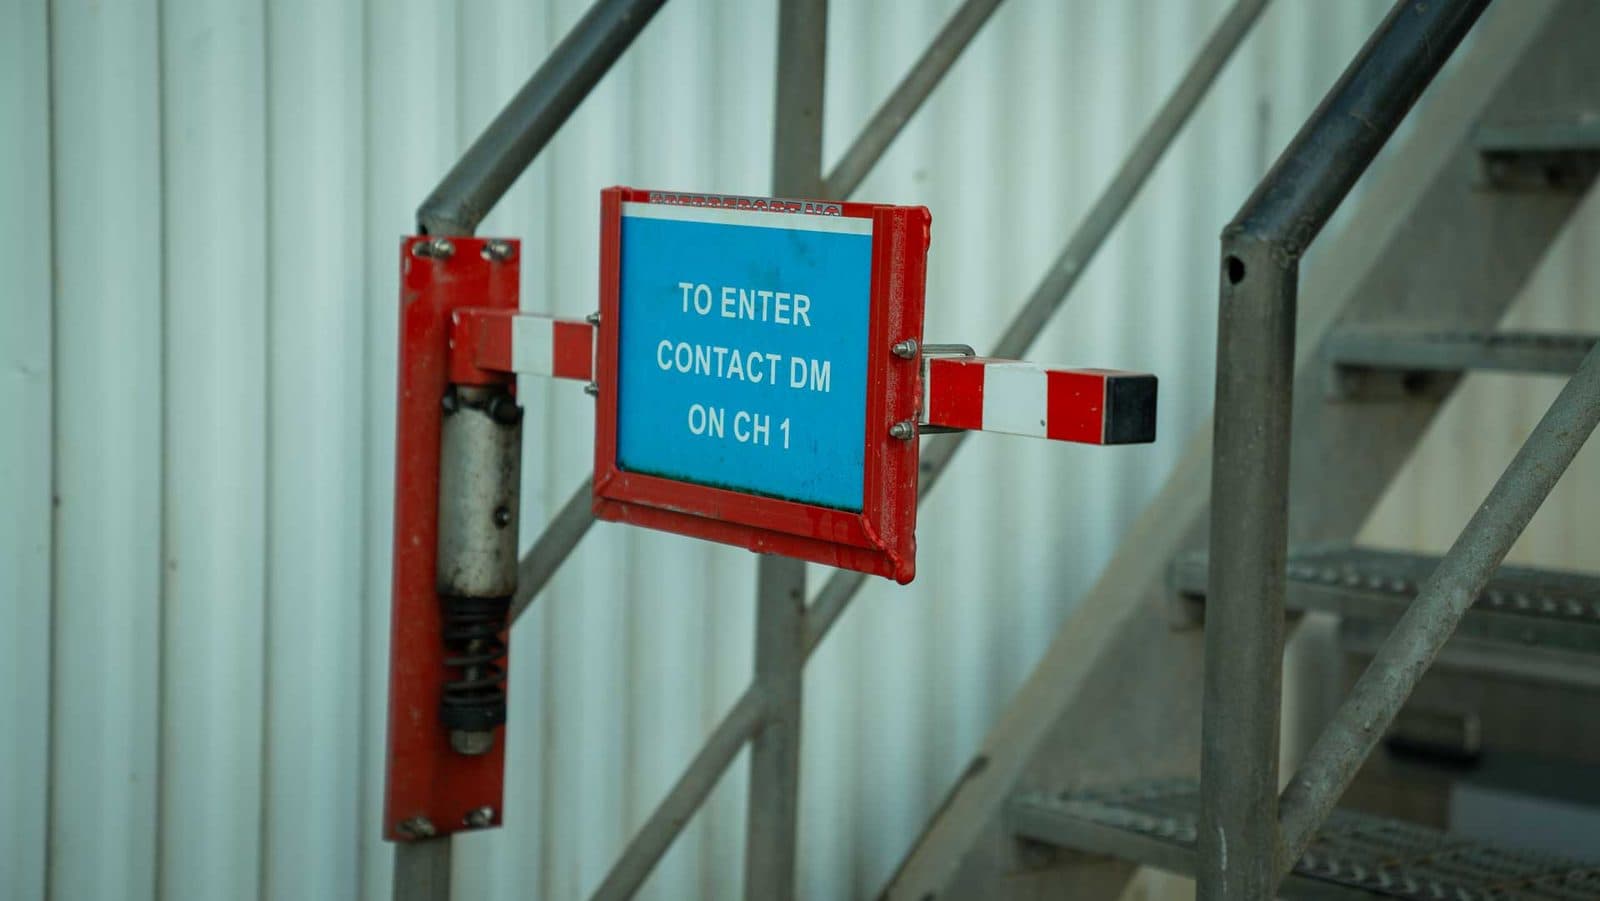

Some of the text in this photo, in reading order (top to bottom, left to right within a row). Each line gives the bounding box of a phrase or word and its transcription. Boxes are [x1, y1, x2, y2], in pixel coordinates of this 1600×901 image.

[679, 282, 811, 327] TO ENTER
[657, 340, 831, 393] CONTACT DM
[688, 404, 790, 449] ON CH 1
